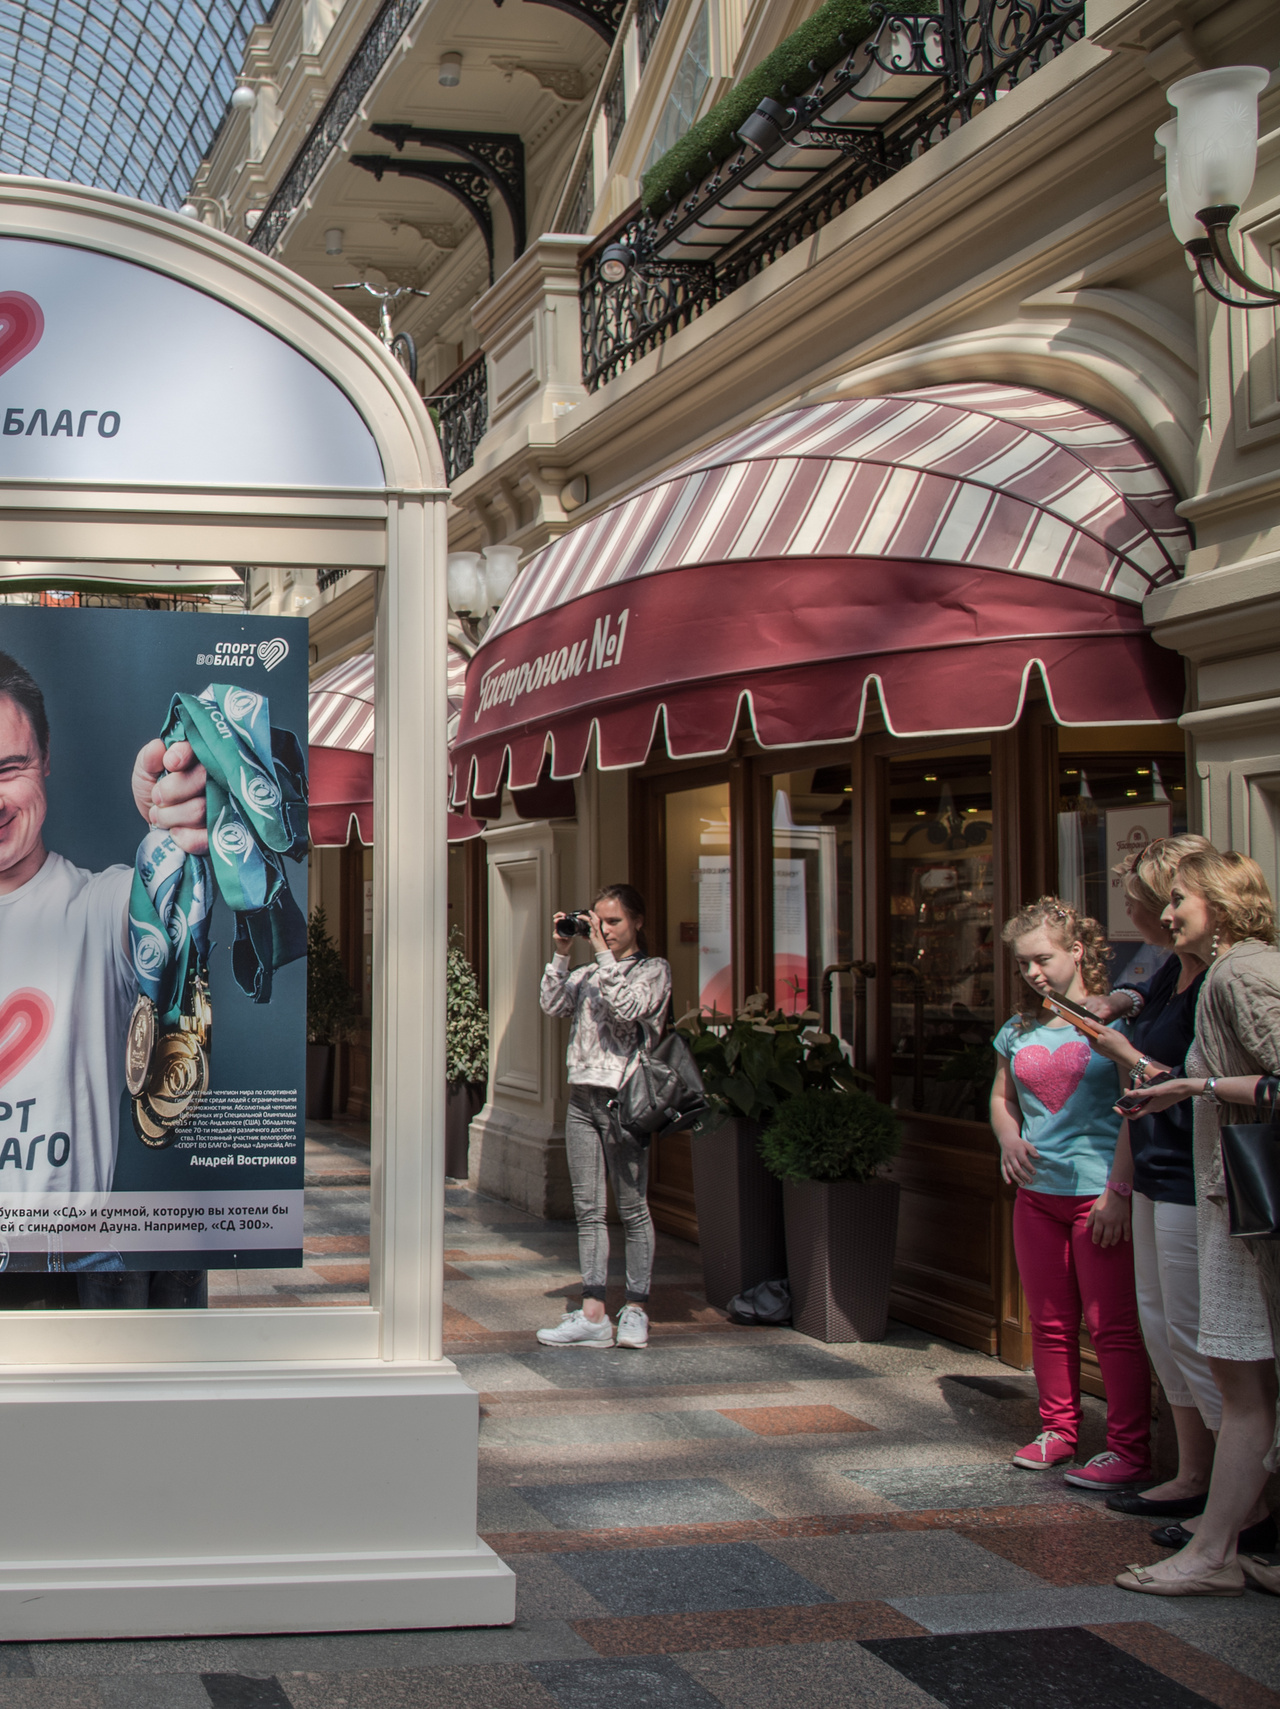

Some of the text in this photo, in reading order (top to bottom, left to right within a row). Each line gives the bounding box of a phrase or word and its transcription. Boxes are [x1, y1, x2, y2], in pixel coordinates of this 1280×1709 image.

[215, 642, 257, 655] СПОРТ
[474, 640, 590, 723] Гастроном
[210, 710, 233, 740] Can
[190, 1155, 296, 1168] Андрей Востриков
[53, 1207, 86, 1218] «СД»
[101, 1206, 149, 1219] суммой,
[153, 1208, 204, 1218] которую
[228, 1207, 268, 1215] хотели
[272, 1205, 288, 1214] бы
[28, 1224, 96, 1234] синдромом
[100, 1222, 140, 1233] Дауна.
[145, 1222, 207, 1233] Например,
[212, 1220, 235, 1231] «СД
[240, 1220, 273, 1229] 300».
